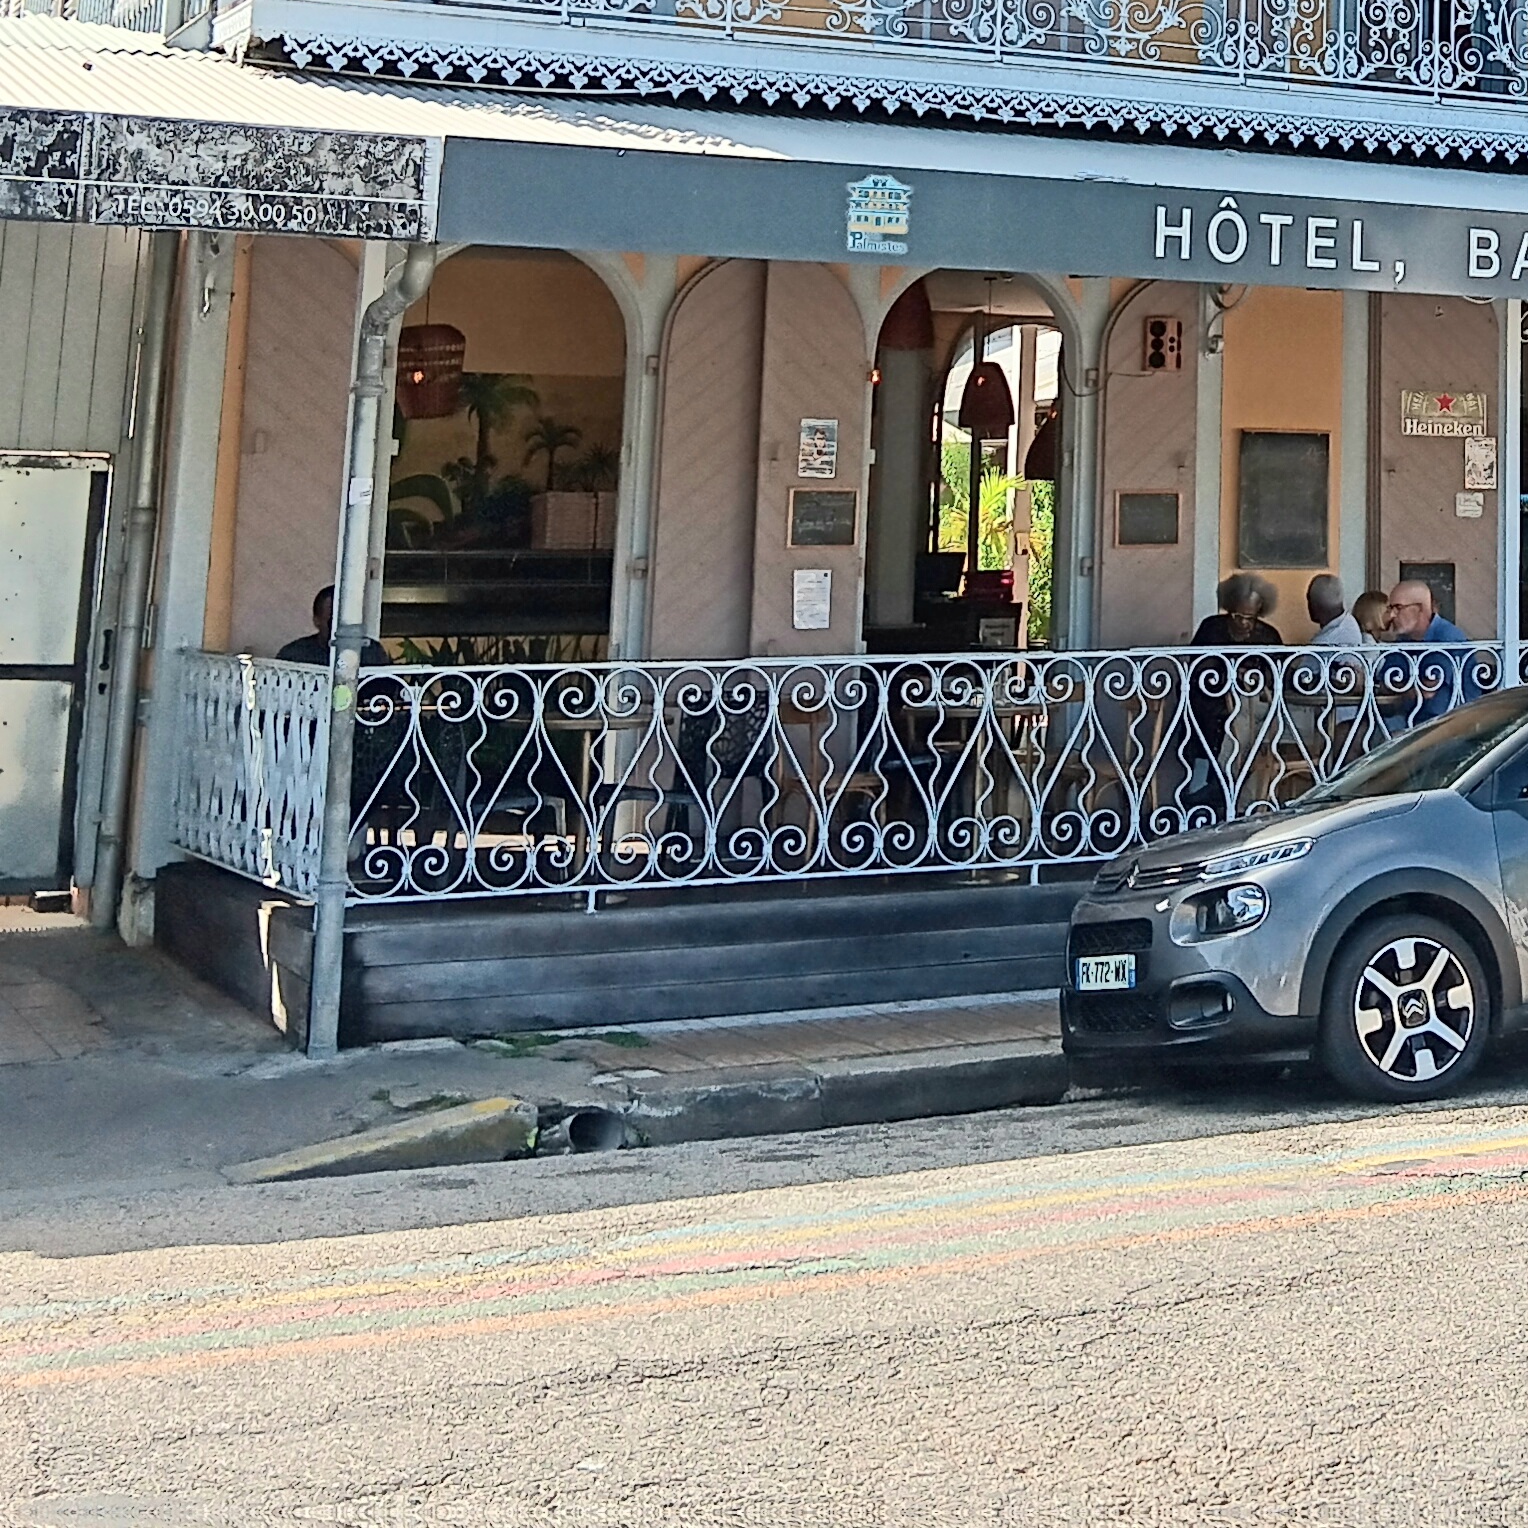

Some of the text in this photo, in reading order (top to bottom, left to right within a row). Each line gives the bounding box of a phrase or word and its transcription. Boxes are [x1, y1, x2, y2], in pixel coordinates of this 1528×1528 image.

[259, 203, 286, 223] 00
[292, 205, 317, 225] 50
[849, 231, 906, 253] Palmistes
[1154, 196, 1406, 284] HÔTEL,
[1402, 417, 1484, 437] Heineken
